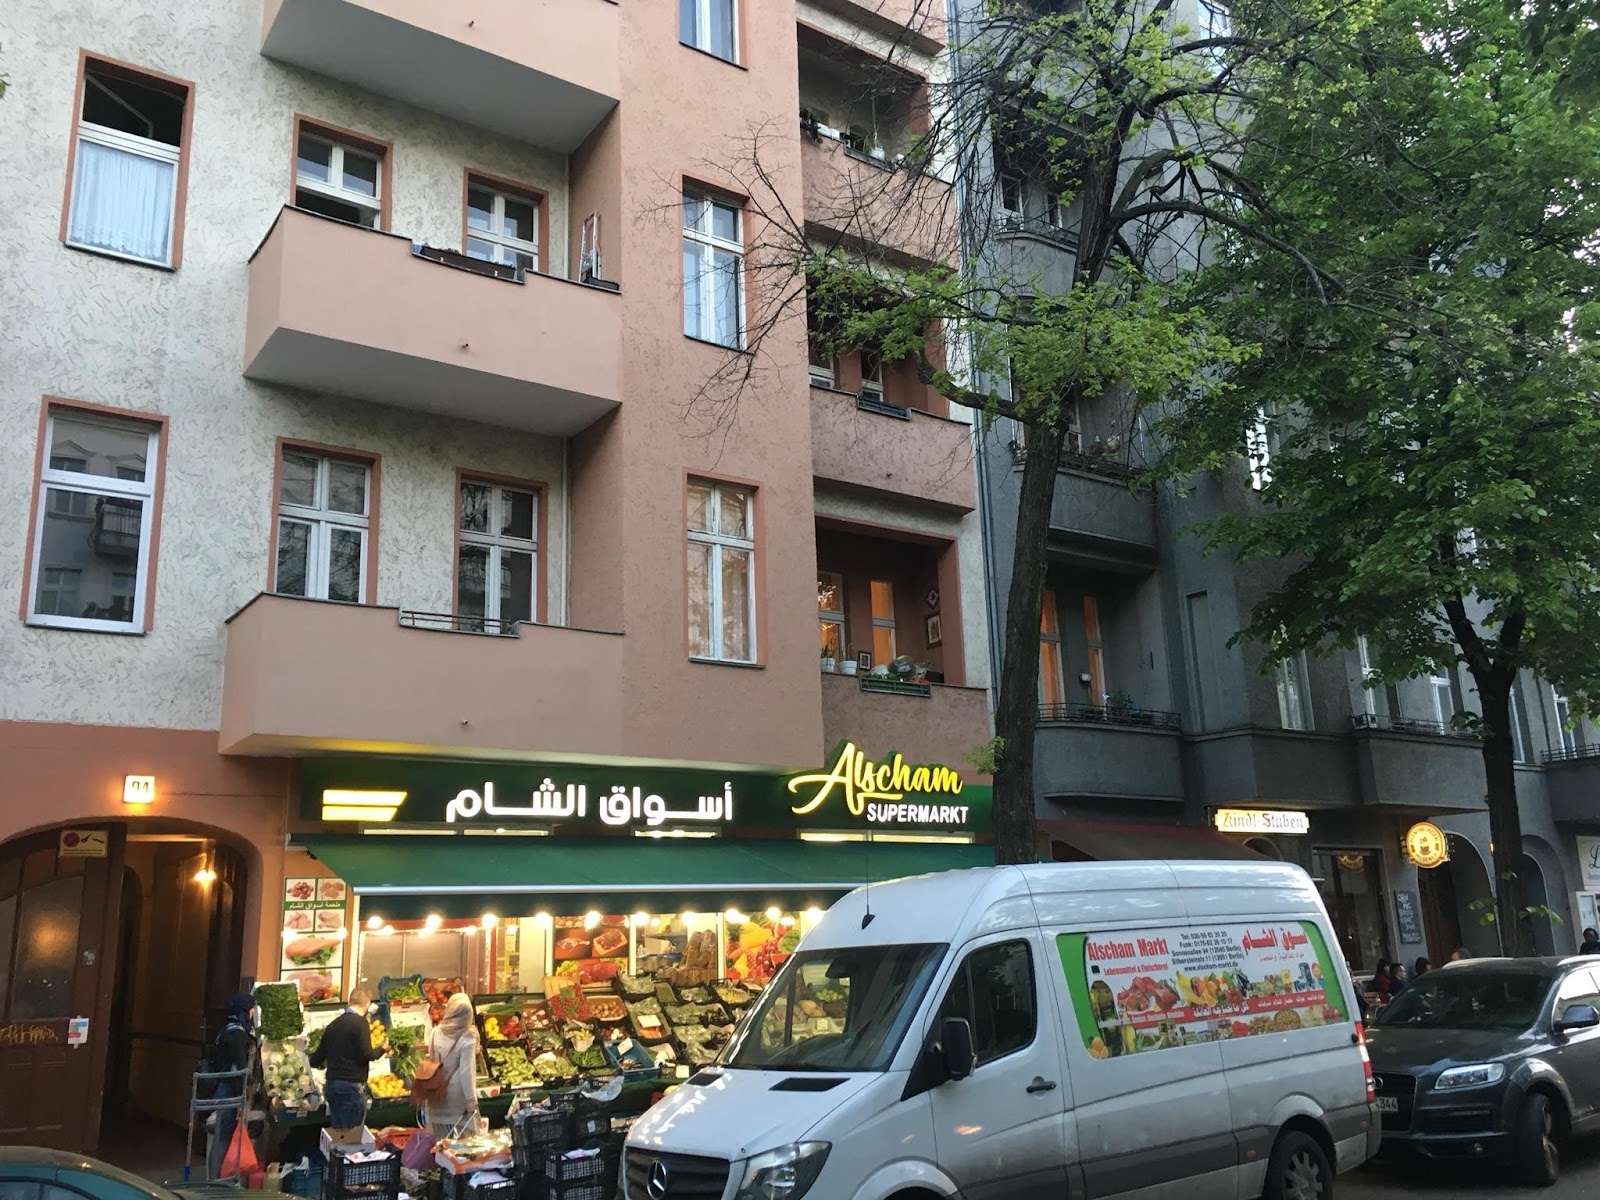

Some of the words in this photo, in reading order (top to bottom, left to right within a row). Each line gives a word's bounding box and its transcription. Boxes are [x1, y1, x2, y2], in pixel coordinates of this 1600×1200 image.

[787, 742, 963, 816] Alscham
[445, 777, 587, 823] الشام
[599, 781, 733, 825] أسواق
[866, 803, 969, 824] SUPERMARKT
[1087, 941, 1136, 961] Alscham
[1136, 937, 1170, 957] Markt
[1242, 928, 1278, 956] الشام
